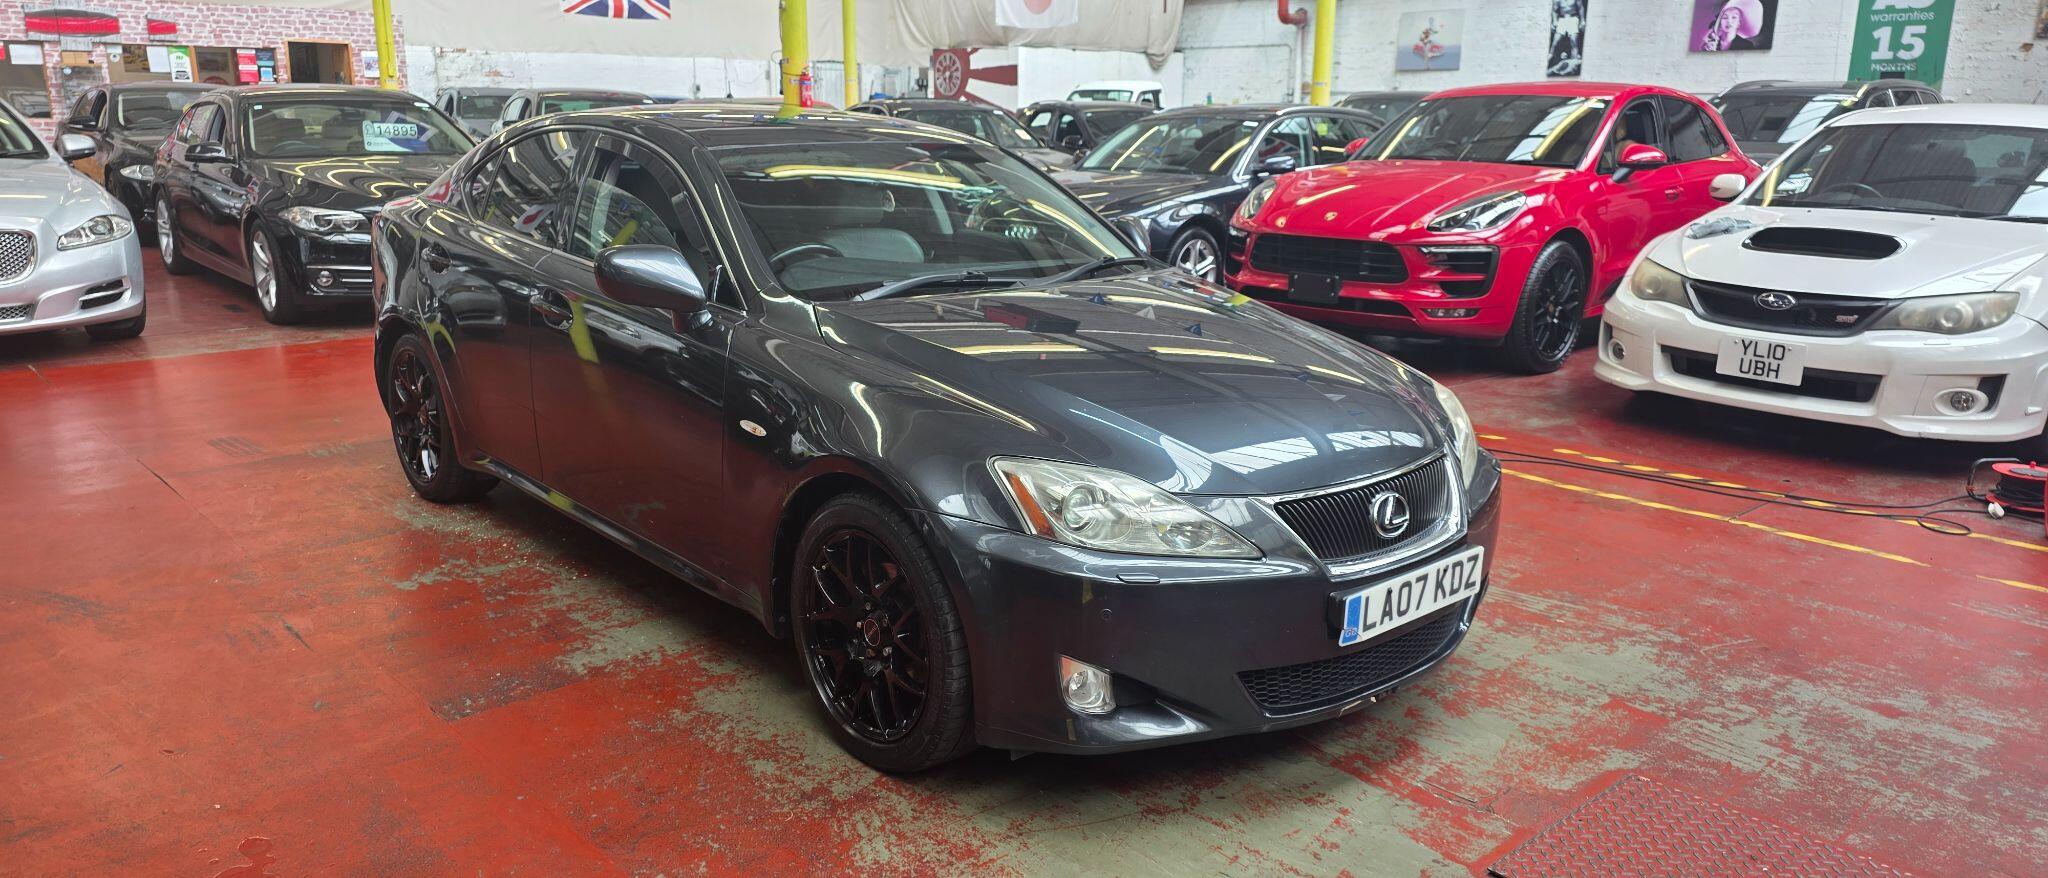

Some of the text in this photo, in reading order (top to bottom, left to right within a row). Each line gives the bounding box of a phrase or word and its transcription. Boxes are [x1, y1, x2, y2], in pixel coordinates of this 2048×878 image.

[1871, 9, 1936, 22] warranties
[1870, 25, 1927, 60] 15
[1870, 62, 1917, 72] MONTHS
[1741, 339, 1786, 361] YL10
[1739, 358, 1780, 379] UBH
[1362, 554, 1480, 633] LA07 KDZ
